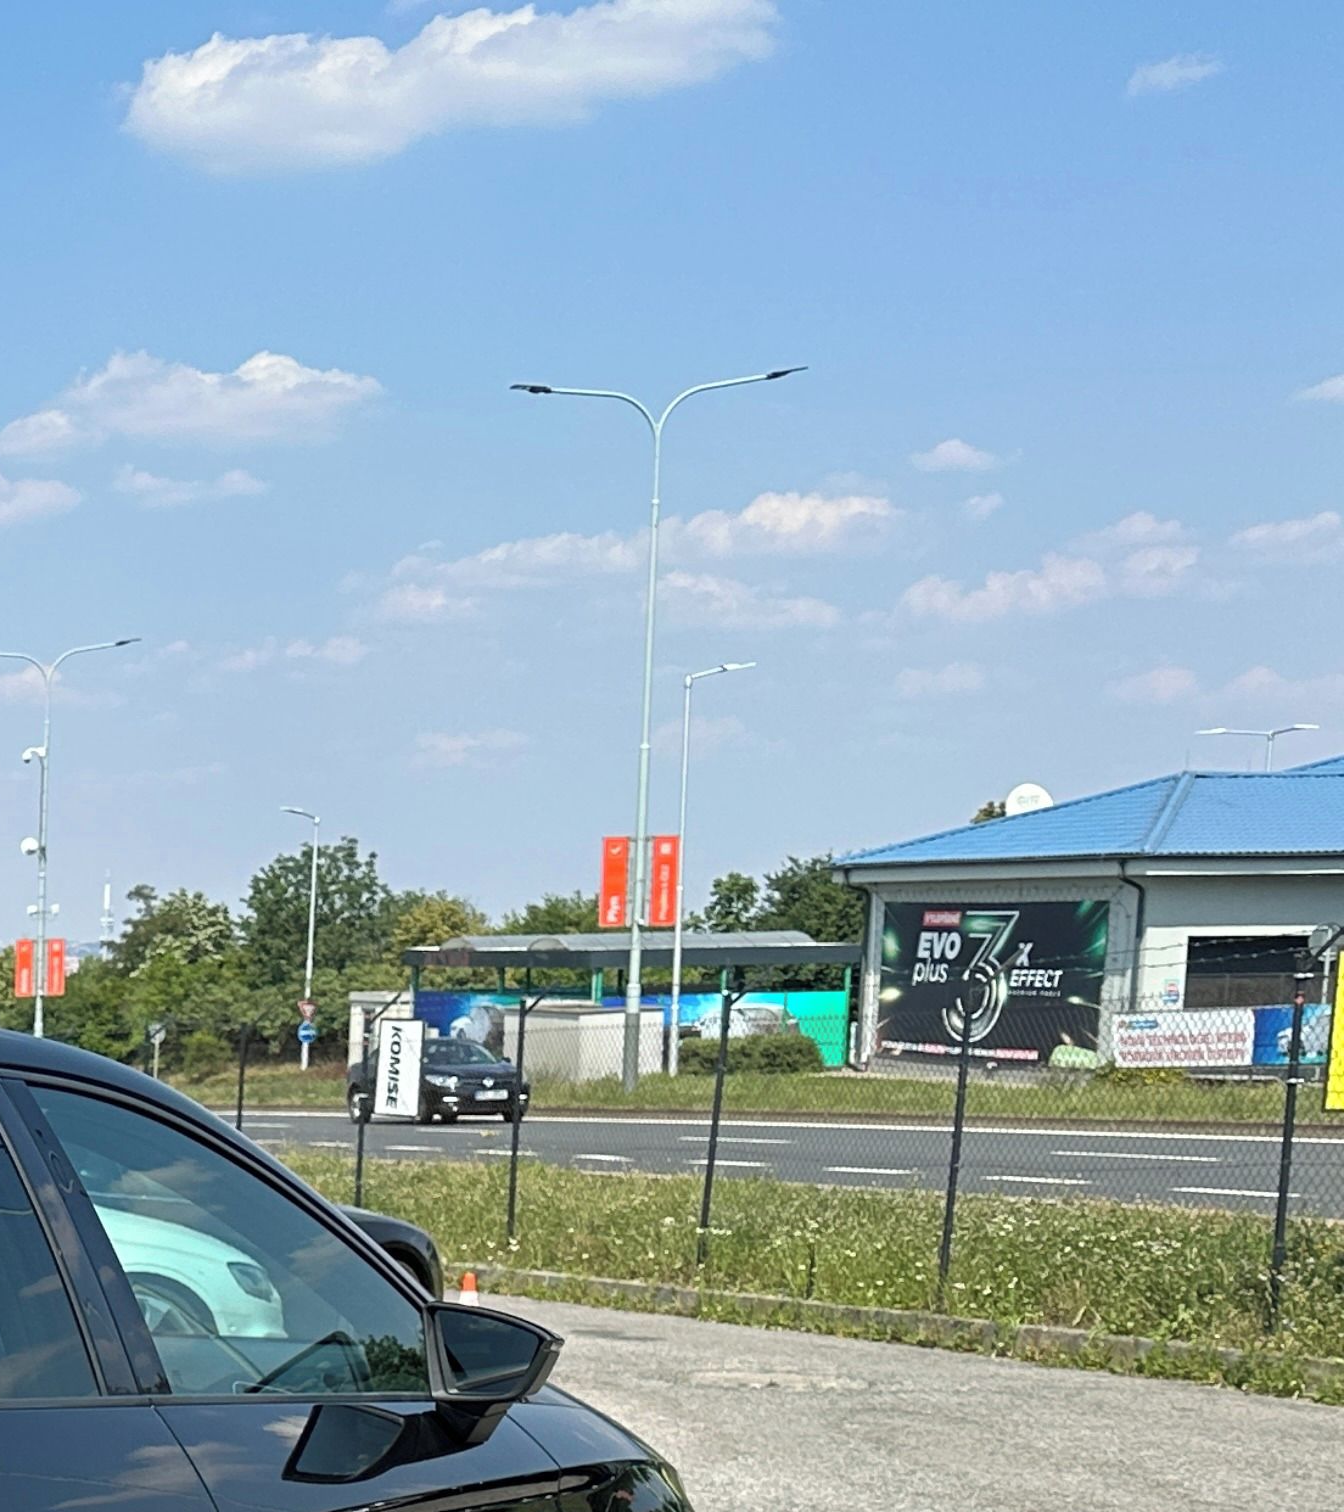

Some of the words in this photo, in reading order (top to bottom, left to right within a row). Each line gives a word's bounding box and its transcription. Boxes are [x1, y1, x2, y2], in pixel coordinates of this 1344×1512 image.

[917, 932, 961, 959] EVO
[912, 957, 949, 986] plus
[1009, 969, 1064, 988] EFFECT
[386, 1025, 403, 1109] KOMISE
